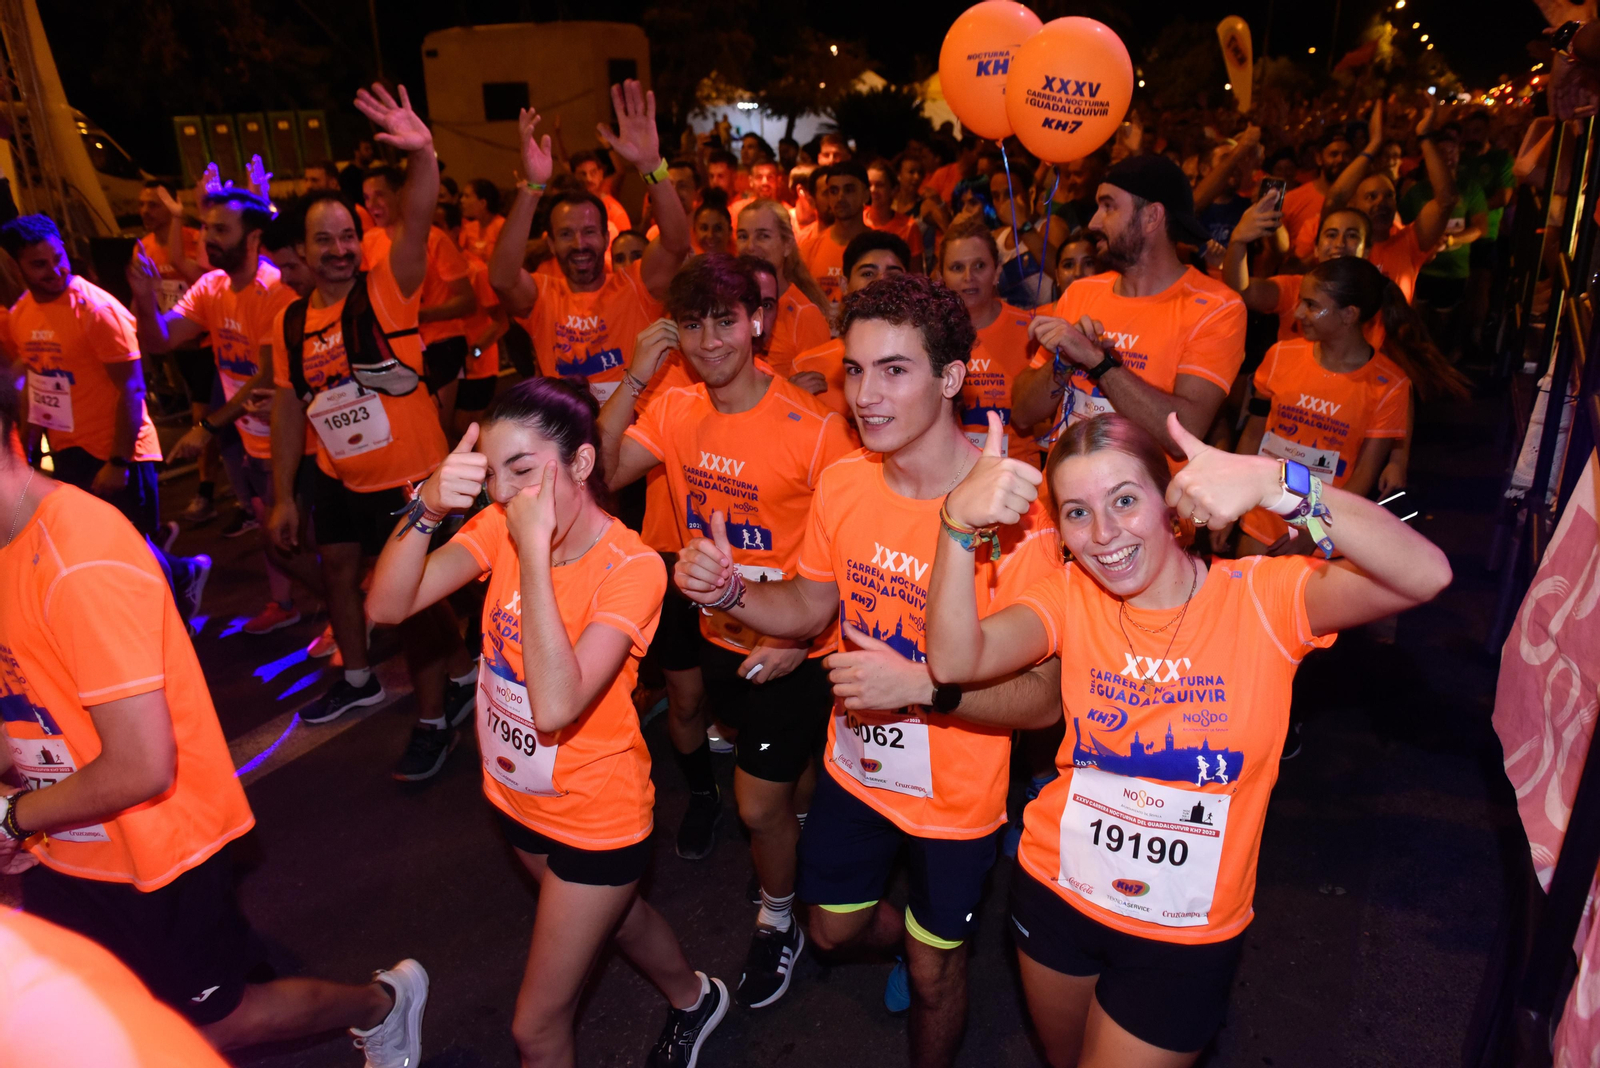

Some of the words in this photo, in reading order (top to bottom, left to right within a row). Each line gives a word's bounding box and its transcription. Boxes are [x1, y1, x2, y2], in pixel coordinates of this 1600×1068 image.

[966, 51, 1010, 61] NOCTURNA
[976, 59, 1010, 77] KH
[1026, 88, 1063, 104] CARRERA
[1064, 98, 1110, 108] NOCTURNA
[1041, 75, 1101, 98] XXXV
[1029, 99, 1109, 117] GUADALQUIVIR
[1103, 331, 1139, 349] XV
[966, 358, 991, 372] XV
[1119, 350, 1148, 361] CTURNA
[1296, 393, 1341, 416] XXXV
[324, 406, 370, 431] 16923
[1281, 412, 1348, 437] GUADALQUIVIR
[699, 450, 745, 477] XXXV
[683, 465, 714, 479] CARRERA
[717, 475, 759, 492] NOCTURNA
[687, 475, 759, 502] GUADALQUIVIR
[871, 541, 929, 582] XXXV
[852, 572, 926, 611] GUAALQUIV
[890, 575, 927, 599] NOCTUR
[909, 612, 926, 631] NO8
[1090, 668, 1147, 693] CARRERA
[1154, 675, 1226, 695] NTURNA
[1096, 684, 1227, 708] GUADALQUIVIR
[486, 707, 537, 757] 17969
[844, 713, 905, 749] 19062
[1109, 809, 1137, 823] NOCTURNA
[1147, 822, 1190, 832] GUADALQUIVIR
[1090, 818, 1189, 866] 19190
[1162, 910, 1200, 918] Cruzcampo
